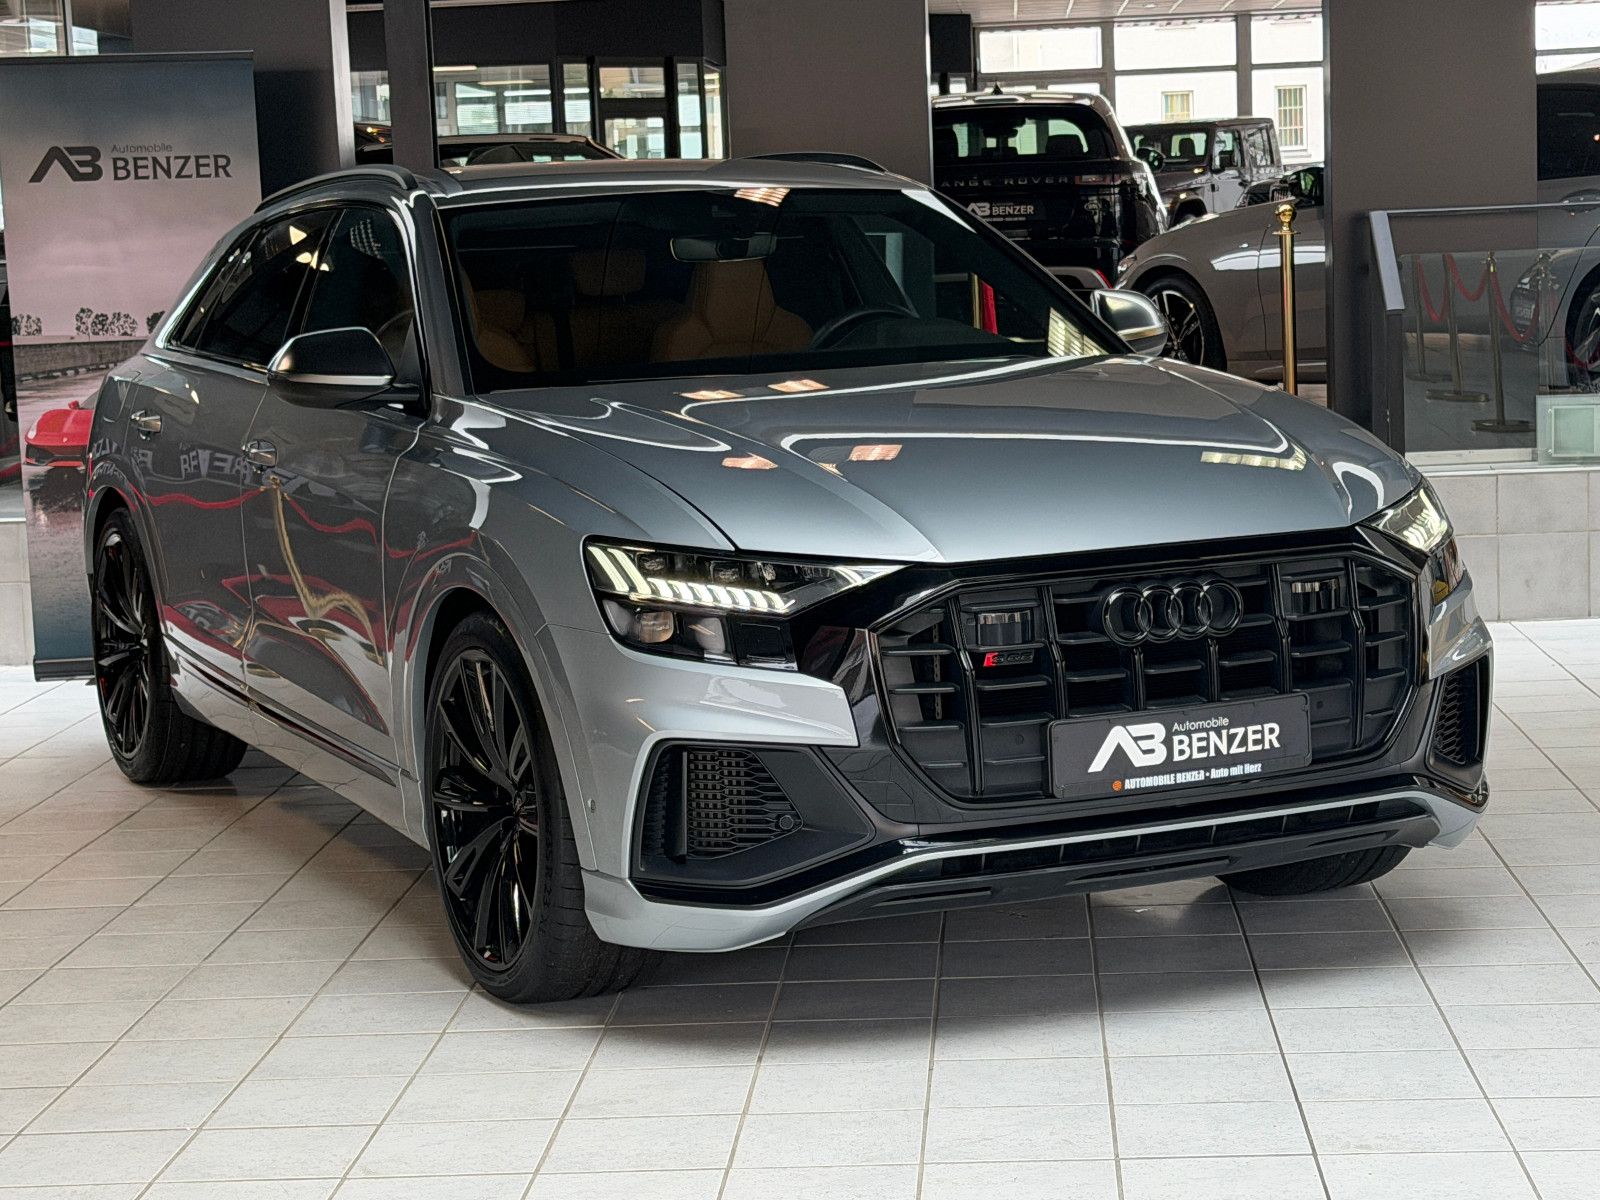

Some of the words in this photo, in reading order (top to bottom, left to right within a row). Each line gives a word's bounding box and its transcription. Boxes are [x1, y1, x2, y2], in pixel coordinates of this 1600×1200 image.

[111, 143, 173, 154] Automobile
[111, 154, 232, 181] BENZER
[941, 178, 992, 187] ANGE
[1004, 176, 1068, 185] ROVER
[992, 205, 1034, 216] BENZER
[1172, 717, 1230, 732] Automobile
[1172, 722, 1280, 762] BENZER
[1124, 773, 1176, 790] AUTOMOBILE
[1176, 769, 1205, 783] BENZER
[1210, 768, 1229, 779] Auto
[1230, 765, 1243, 776] mit
[1245, 763, 1262, 774] Herz
